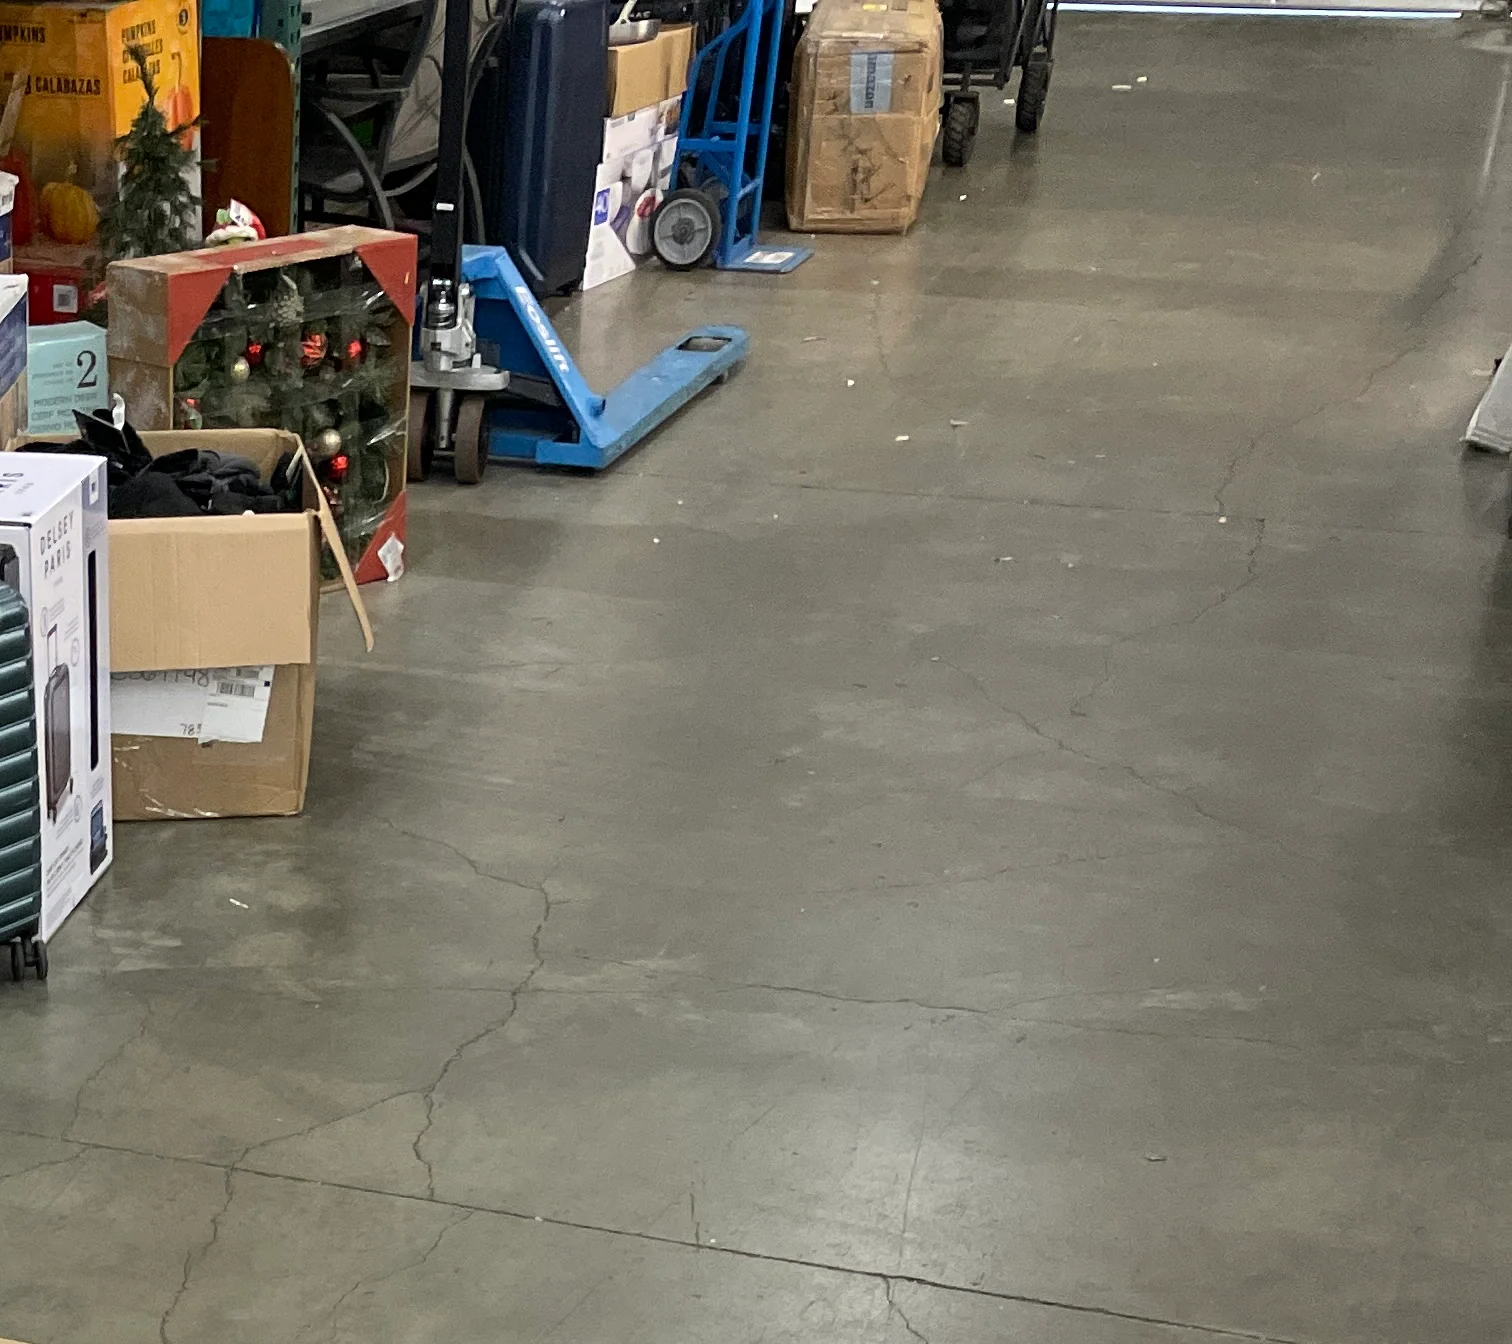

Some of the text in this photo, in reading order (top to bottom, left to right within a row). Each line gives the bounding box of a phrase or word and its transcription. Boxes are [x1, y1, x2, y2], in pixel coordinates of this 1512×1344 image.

[75, 349, 97, 389] 2
[40, 510, 75, 556] DELSEY
[44, 540, 71, 579] PARIS
